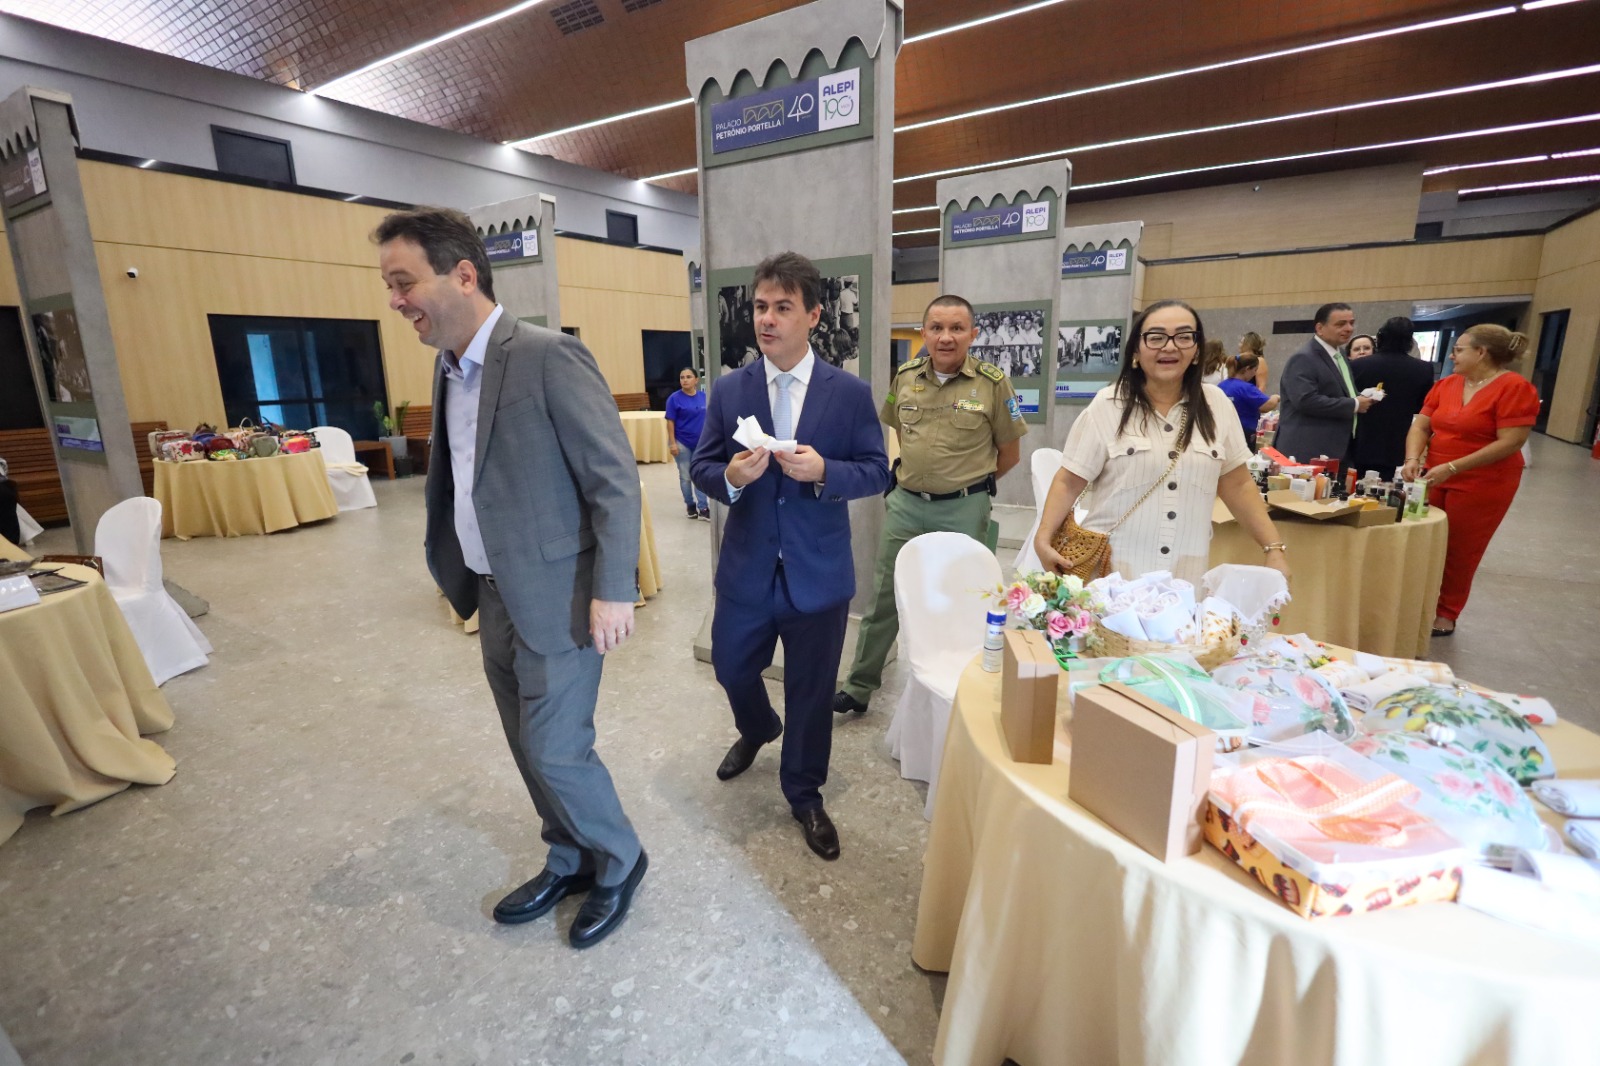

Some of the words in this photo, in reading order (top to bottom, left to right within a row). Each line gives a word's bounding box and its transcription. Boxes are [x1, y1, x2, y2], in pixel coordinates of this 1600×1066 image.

[823, 80, 854, 96] ALEPI
[787, 93, 814, 122] 40
[823, 95, 853, 121] 190
[716, 126, 747, 140] PETRÔNIO
[747, 119, 782, 133] PORTELLA
[1025, 207, 1046, 215] ALEPI
[1002, 212, 1020, 228] 40
[511, 238, 522, 252] 40
[1091, 255, 1105, 267] 40
